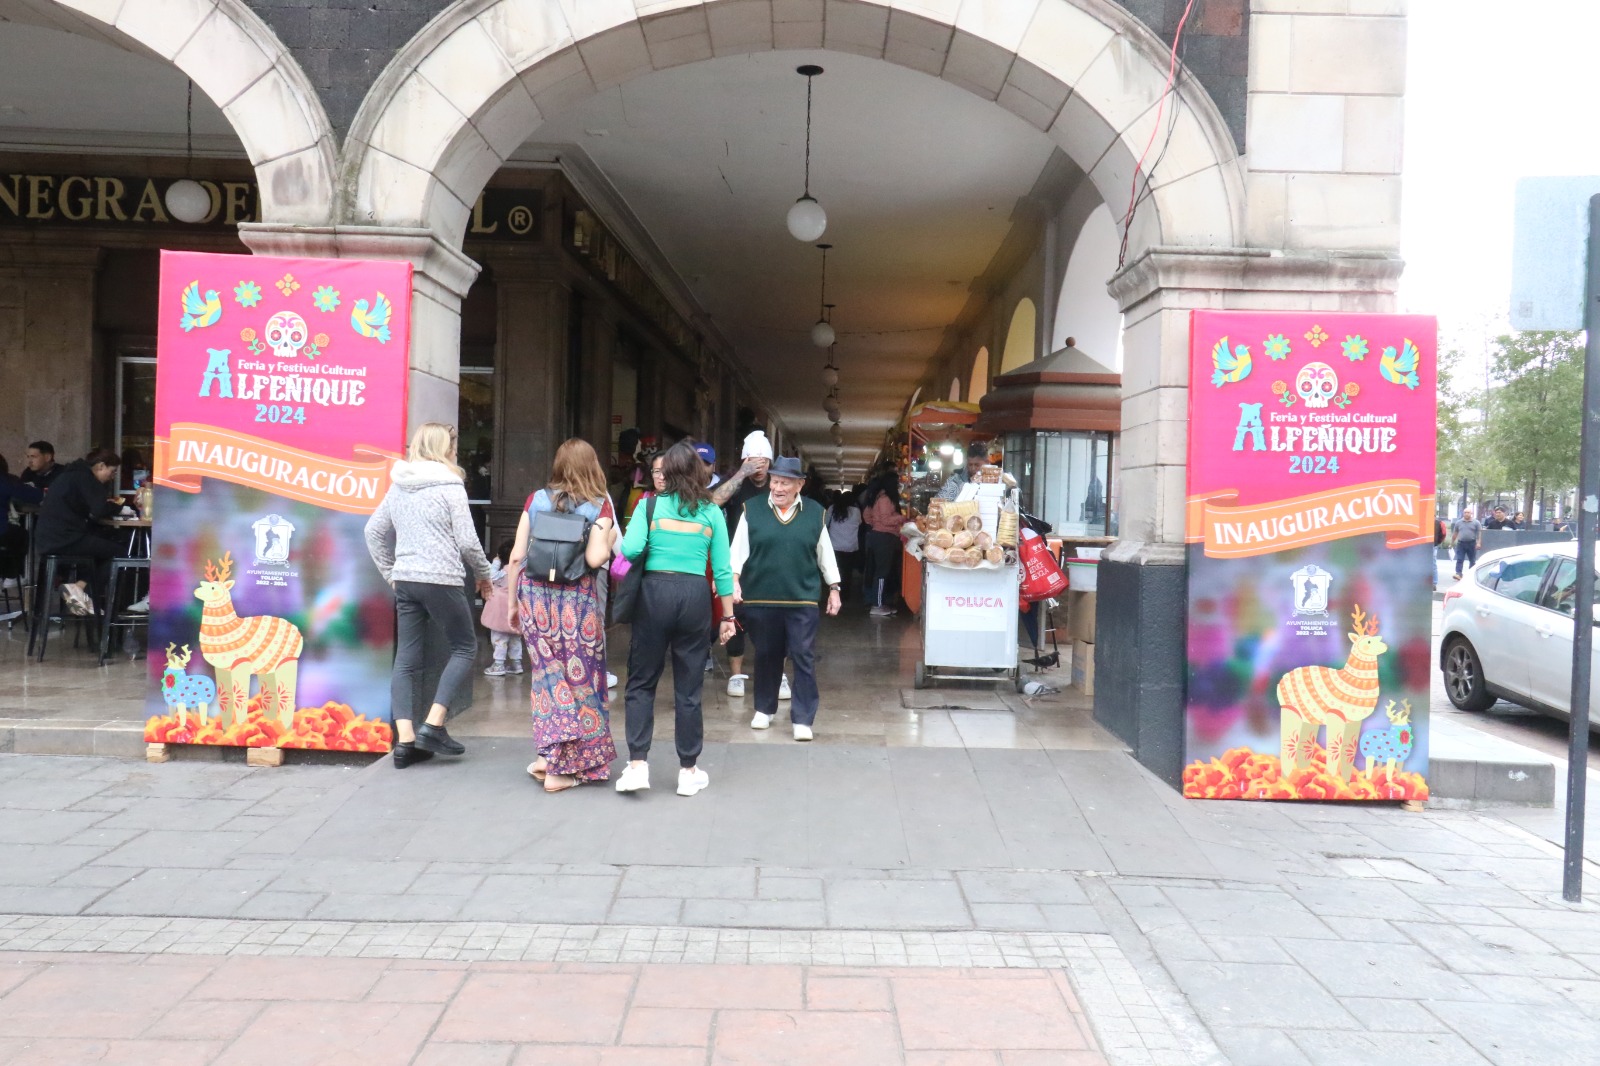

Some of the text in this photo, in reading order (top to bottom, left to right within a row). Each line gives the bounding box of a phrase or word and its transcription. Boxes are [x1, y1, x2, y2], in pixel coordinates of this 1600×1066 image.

[238, 359, 367, 377] Feria y Festival Cultural
[255, 404, 307, 424] 2024
[1270, 412, 1397, 425] Feria y Festival Cultural
[176, 440, 380, 499] INAUGURACIÓN
[1288, 455, 1340, 474] 2024
[1213, 488, 1414, 544] INAUGURACIÓN
[945, 596, 1004, 608] TOLUCA
